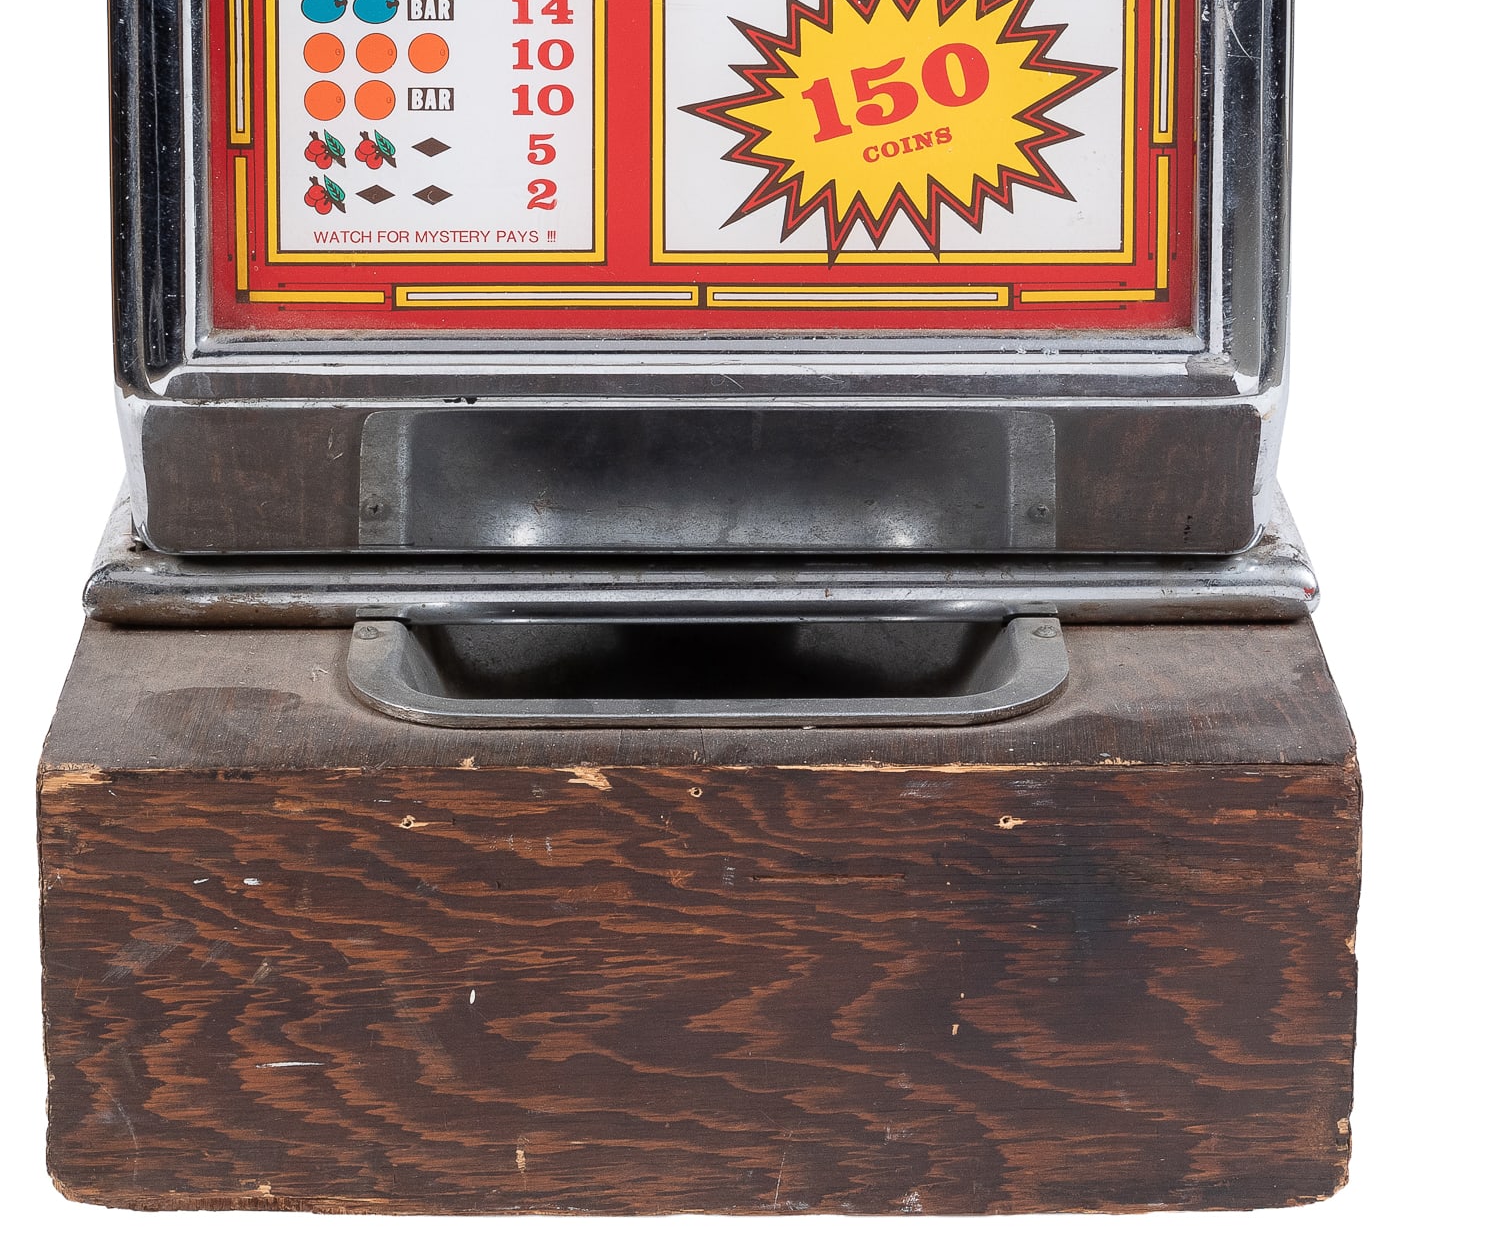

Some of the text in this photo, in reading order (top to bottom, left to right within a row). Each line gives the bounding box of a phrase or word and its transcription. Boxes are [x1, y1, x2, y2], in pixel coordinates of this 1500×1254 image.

[410, 0, 451, 20] BAR
[511, 38, 575, 71] 10
[411, 84, 575, 117] BAR 10
[801, 42, 990, 143] 150
[527, 133, 557, 166] 5
[862, 126, 953, 163] COINS
[527, 178, 558, 211] 2
[313, 230, 372, 244] WATCH
[377, 230, 410, 244] FOR
[415, 230, 491, 244] MYSTERY
[496, 230, 539, 244] PAYS
